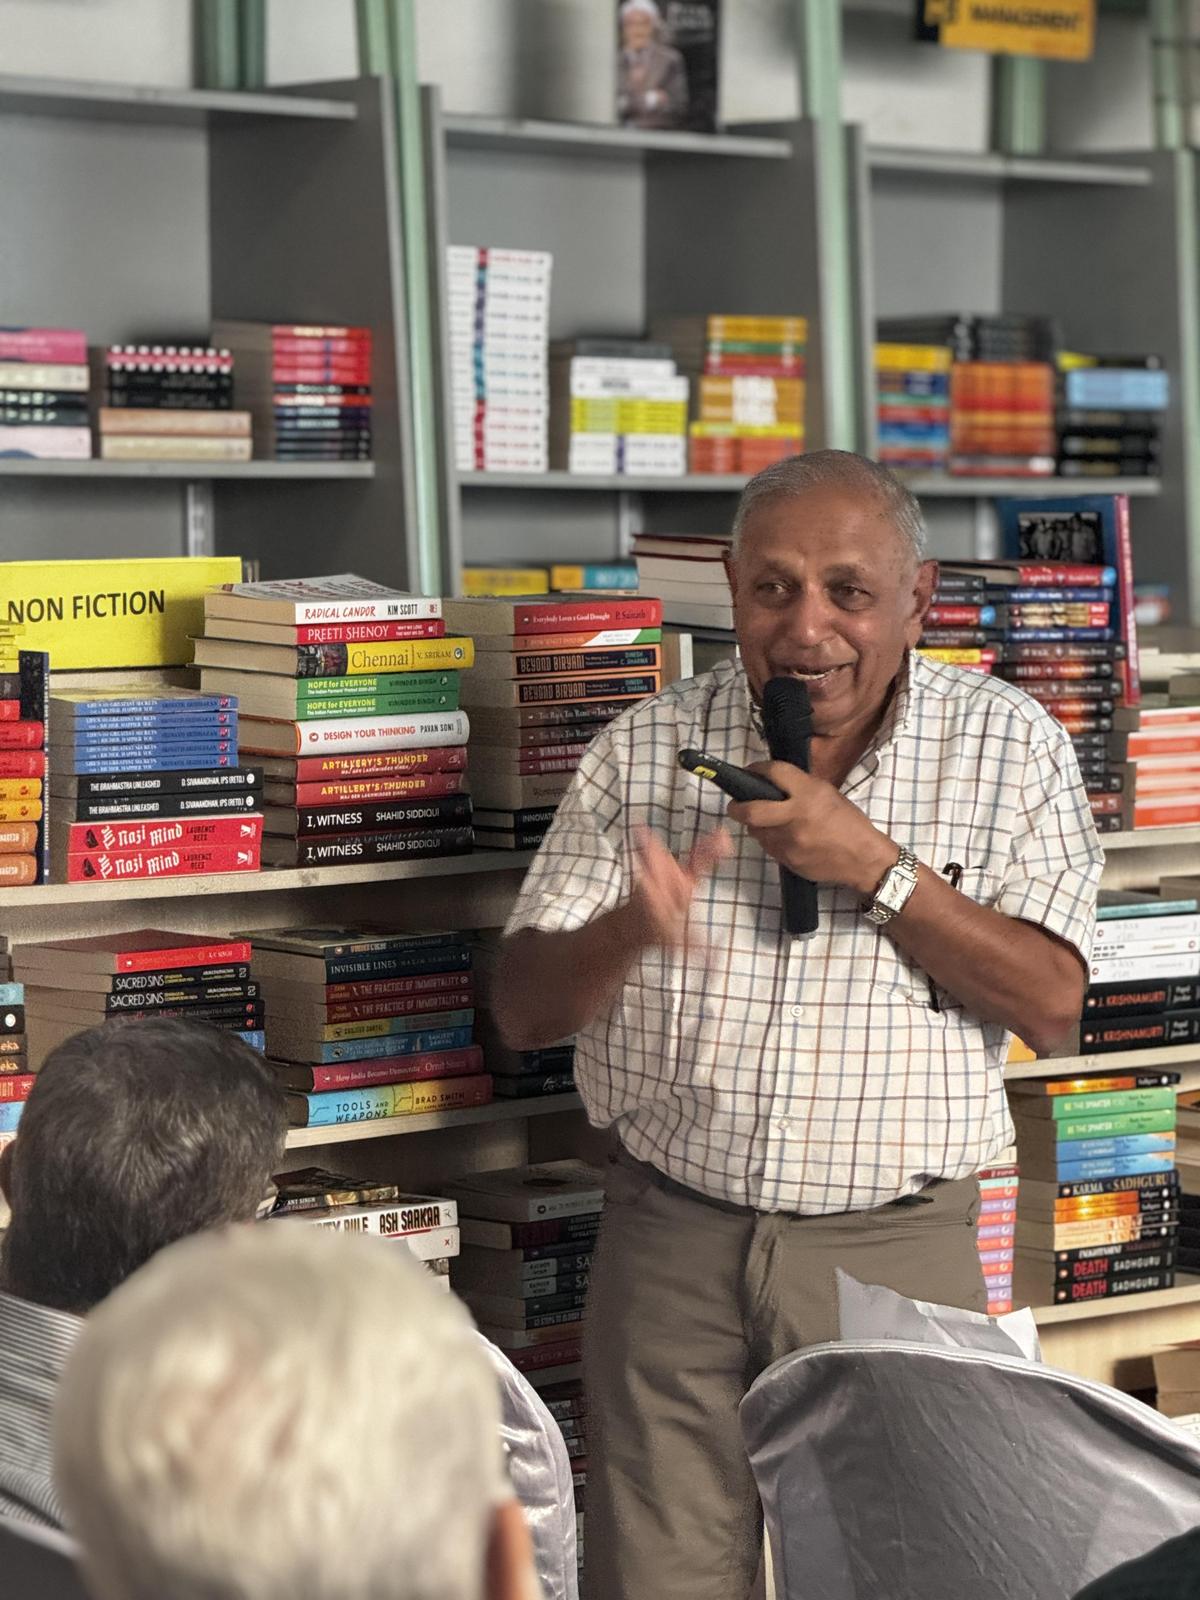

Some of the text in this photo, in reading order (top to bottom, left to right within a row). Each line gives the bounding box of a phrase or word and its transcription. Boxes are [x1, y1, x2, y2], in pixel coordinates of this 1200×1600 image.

[8, 590, 165, 623] NON FICTION
[305, 606, 376, 620] RADICAL CANDOR
[387, 604, 418, 616] KIM SCOTT
[590, 612, 610, 621] Drought
[622, 610, 646, 620] Sainath
[307, 627, 342, 642] PREETI
[346, 625, 389, 639] SHENOY
[352, 650, 408, 668] Chennai
[425, 651, 451, 659] SRIRAM
[520, 657, 551, 672] BEYOND
[554, 655, 585, 671] BIRYANI
[308, 681, 327, 689] HOPE
[340, 679, 377, 688] EVERYONE
[523, 685, 553, 700] BEYOND
[555, 682, 586, 698] BIRYANI
[307, 699, 376, 710] HOPE for EVERYONE
[323, 726, 416, 740] DESIGN YOUR THINKING
[420, 723, 454, 733] PAVAN SONI
[322, 754, 429, 771] ARTILLERY'S THUNDER
[91, 780, 160, 792] THE BRAHMASTRA UNLEASHED
[321, 780, 426, 795] ARTILLERY'S THUNDER
[89, 802, 159, 815] THE BRAHMASTRA UNLEASHED
[376, 808, 440, 822] SHAHID SIDDIQUI
[317, 812, 362, 826] WITNESS
[118, 825, 146, 847] Nazi
[150, 822, 183, 847] Mind
[186, 825, 215, 834] LAURENCE
[317, 843, 363, 857] WITNESS
[376, 839, 440, 853] SHAHID SIDDIQUI
[115, 853, 143, 875] Nazi
[147, 851, 180, 875] Mind
[183, 853, 212, 862] LAURENCE
[331, 960, 397, 974] INVISIBLE LINES
[116, 977, 147, 990] SACRED
[148, 974, 164, 987] SINS
[360, 976, 459, 995] THE PRACTICE OF IMMORTALITY
[111, 994, 145, 1008] SACRED
[146, 992, 164, 1005] SINS
[362, 995, 459, 1015] THE PRACTICE OF IMMORTALITY
[336, 1074, 349, 1082] How
[415, 1092, 465, 1105] BRAD SMITH
[336, 1101, 371, 1113] TOOLS
[336, 1109, 388, 1122] WEAPONS
[1073, 1173, 1168, 1195] KARMA SADHGURU
[380, 1206, 440, 1235] ASH SARKAR
[1073, 1256, 1161, 1276] DEATH SADHGURU
[1072, 1277, 1159, 1297] DEATH SADHGURU
